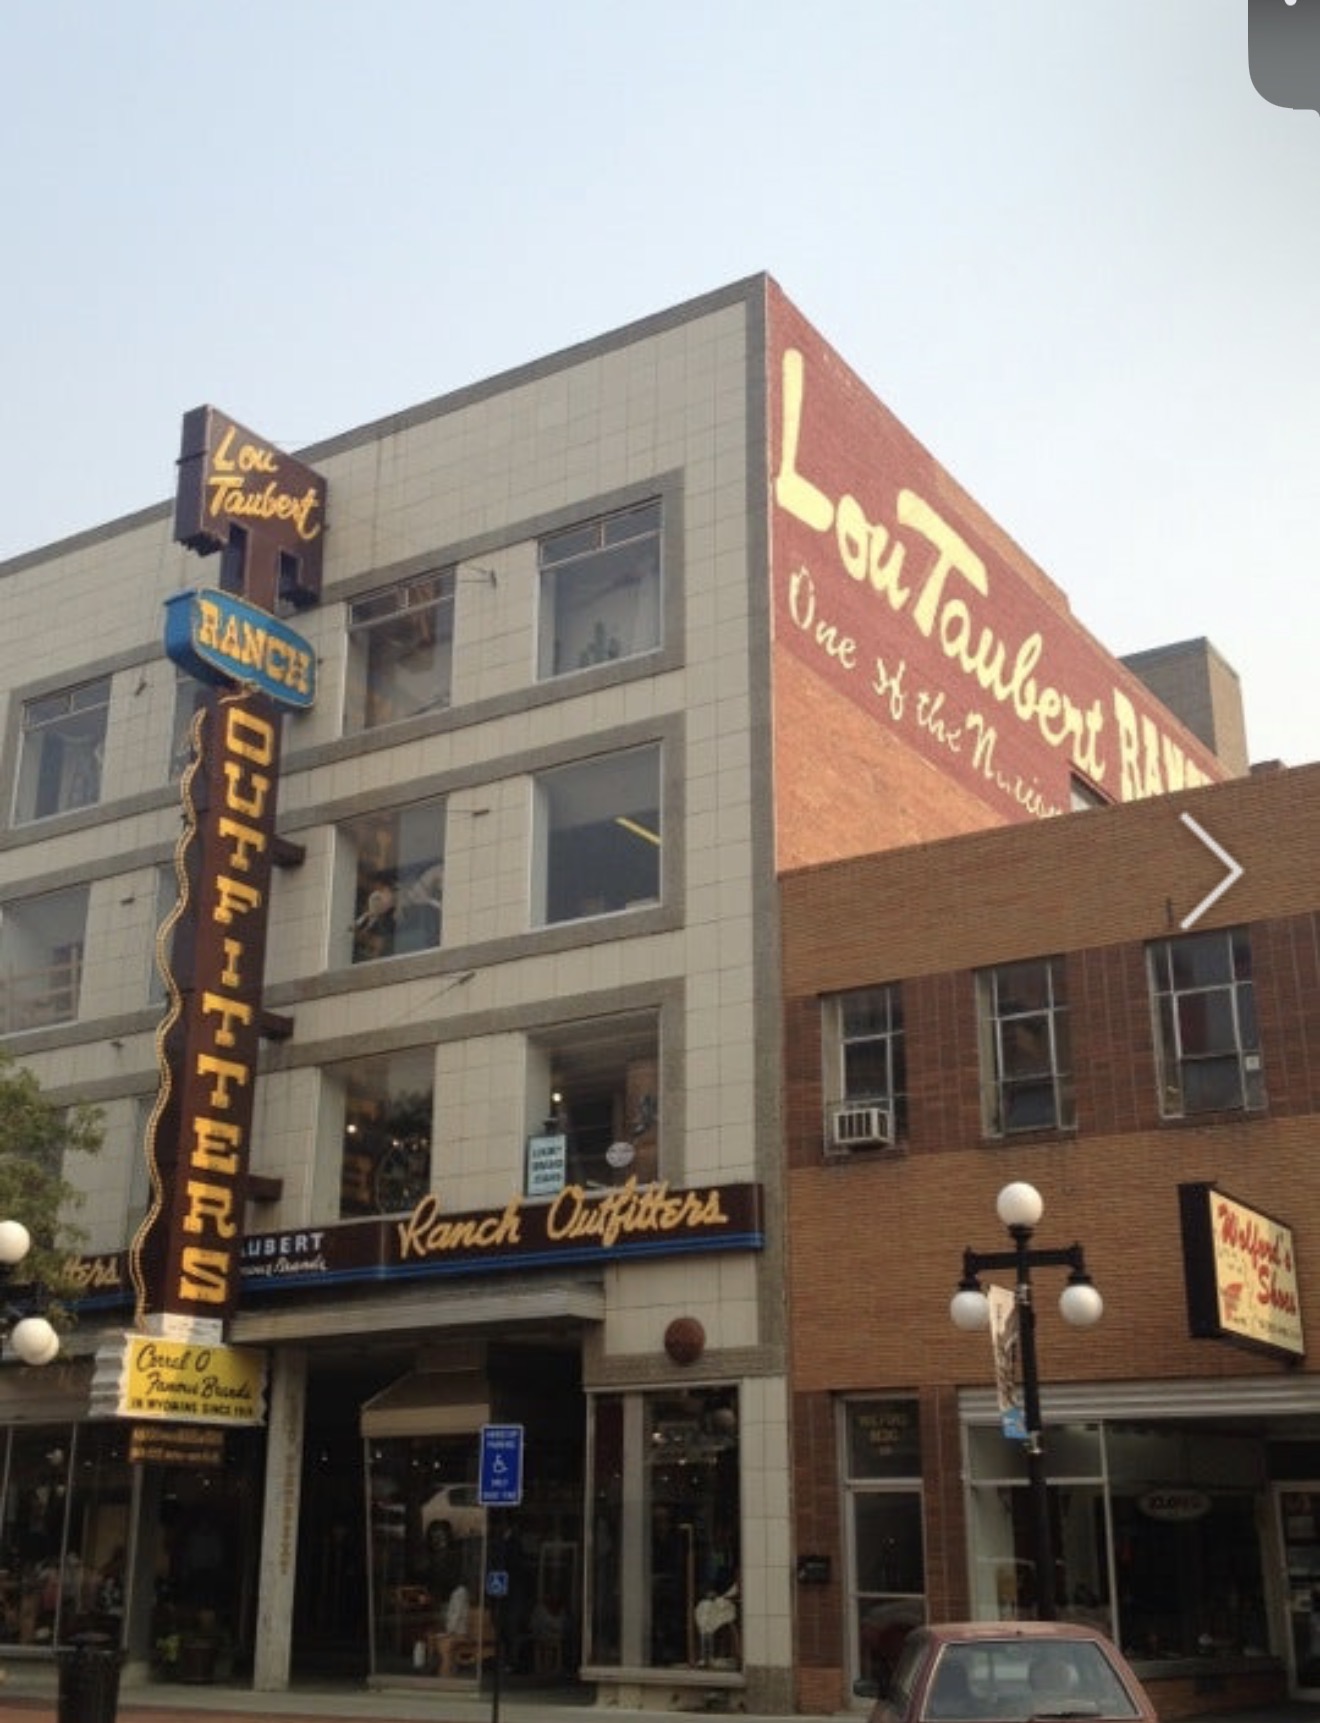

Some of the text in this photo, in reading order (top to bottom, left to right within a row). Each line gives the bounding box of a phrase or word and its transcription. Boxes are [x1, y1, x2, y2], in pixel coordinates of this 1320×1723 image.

[213, 426, 278, 472] Lou
[208, 476, 321, 540] Taubert
[776, 347, 910, 612] Lou
[897, 489, 1107, 783] Taubert
[197, 600, 311, 694] RANCH
[788, 566, 858, 669] One
[917, 692, 961, 754] the
[178, 706, 276, 1305] OUTFITTERS
[241, 1231, 324, 1258] UBERT
[399, 1175, 728, 1258] Ranch Outfitters
[145, 1373, 252, 1399] Famous Brands
